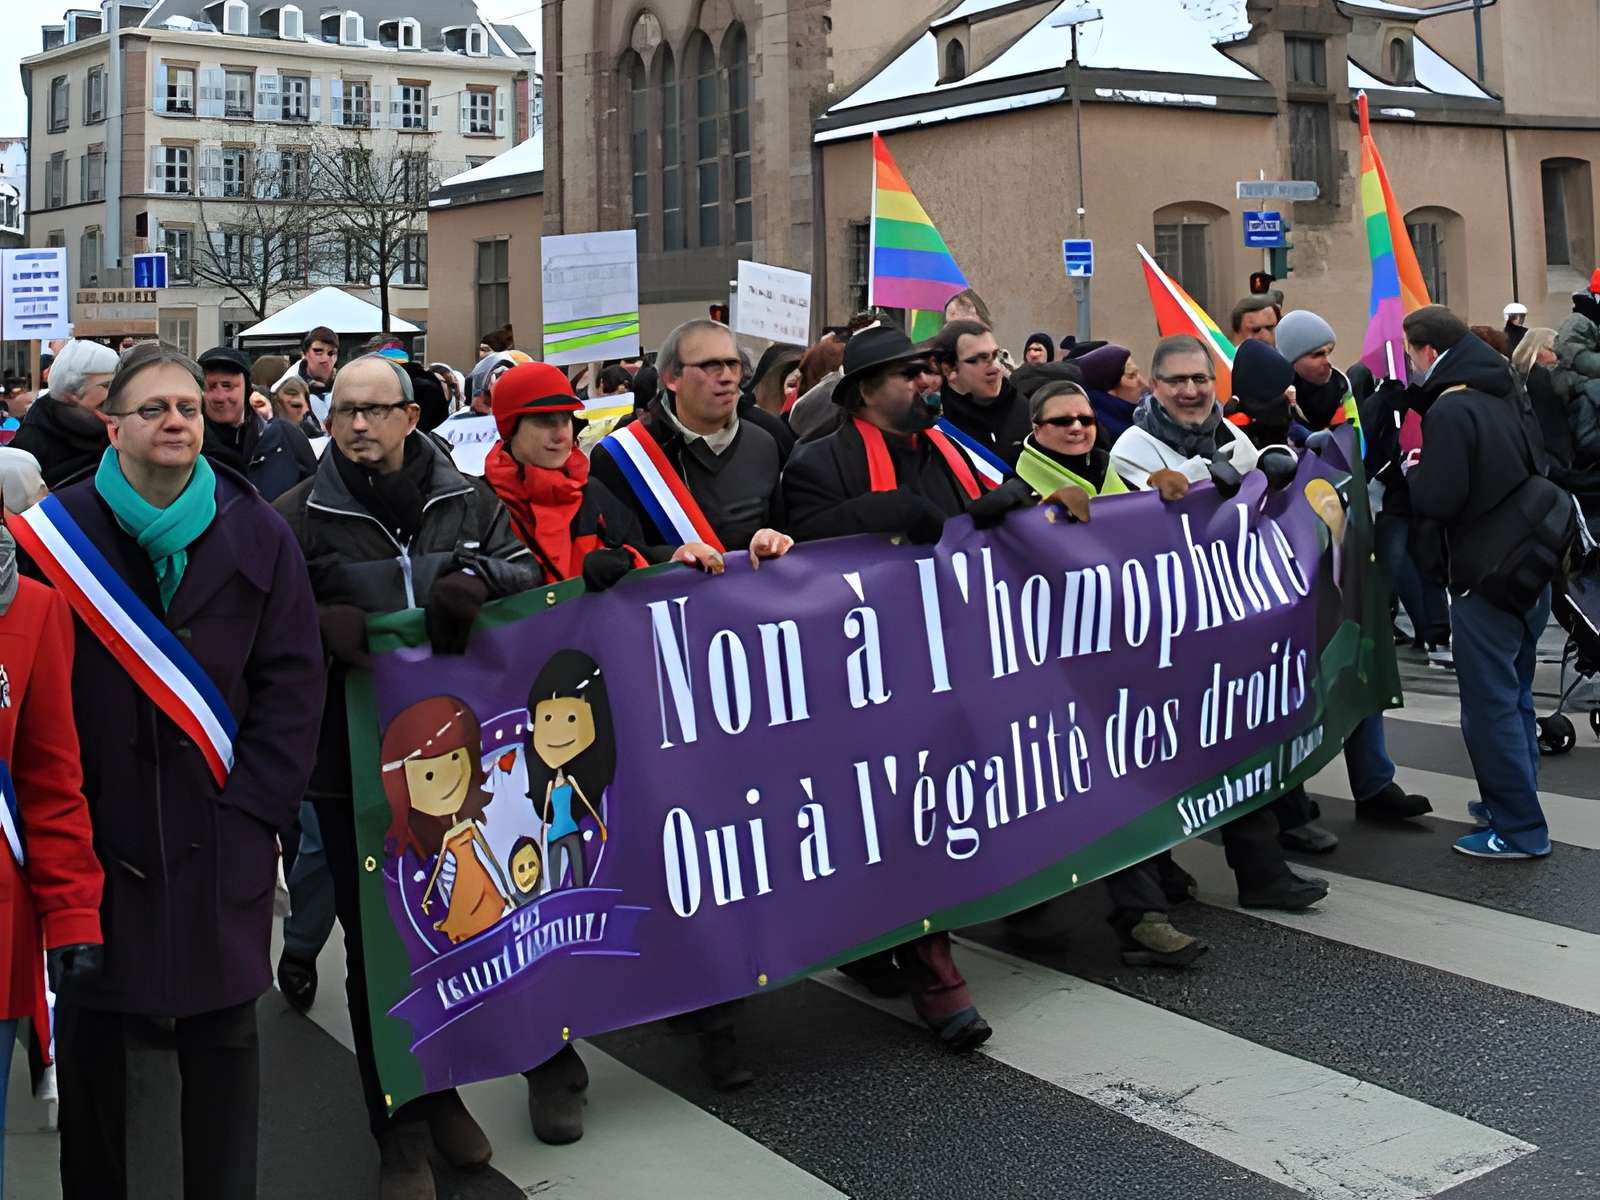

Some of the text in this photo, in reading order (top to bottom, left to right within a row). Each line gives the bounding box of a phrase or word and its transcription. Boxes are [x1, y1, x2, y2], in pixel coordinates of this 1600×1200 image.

[647, 597, 811, 749] Non
[842, 572, 893, 709] à
[663, 789, 773, 918] Oui
[798, 778, 837, 881] à
[854, 702, 1092, 860] l'égalité
[1105, 688, 1180, 778] des
[1200, 637, 1308, 748] droits
